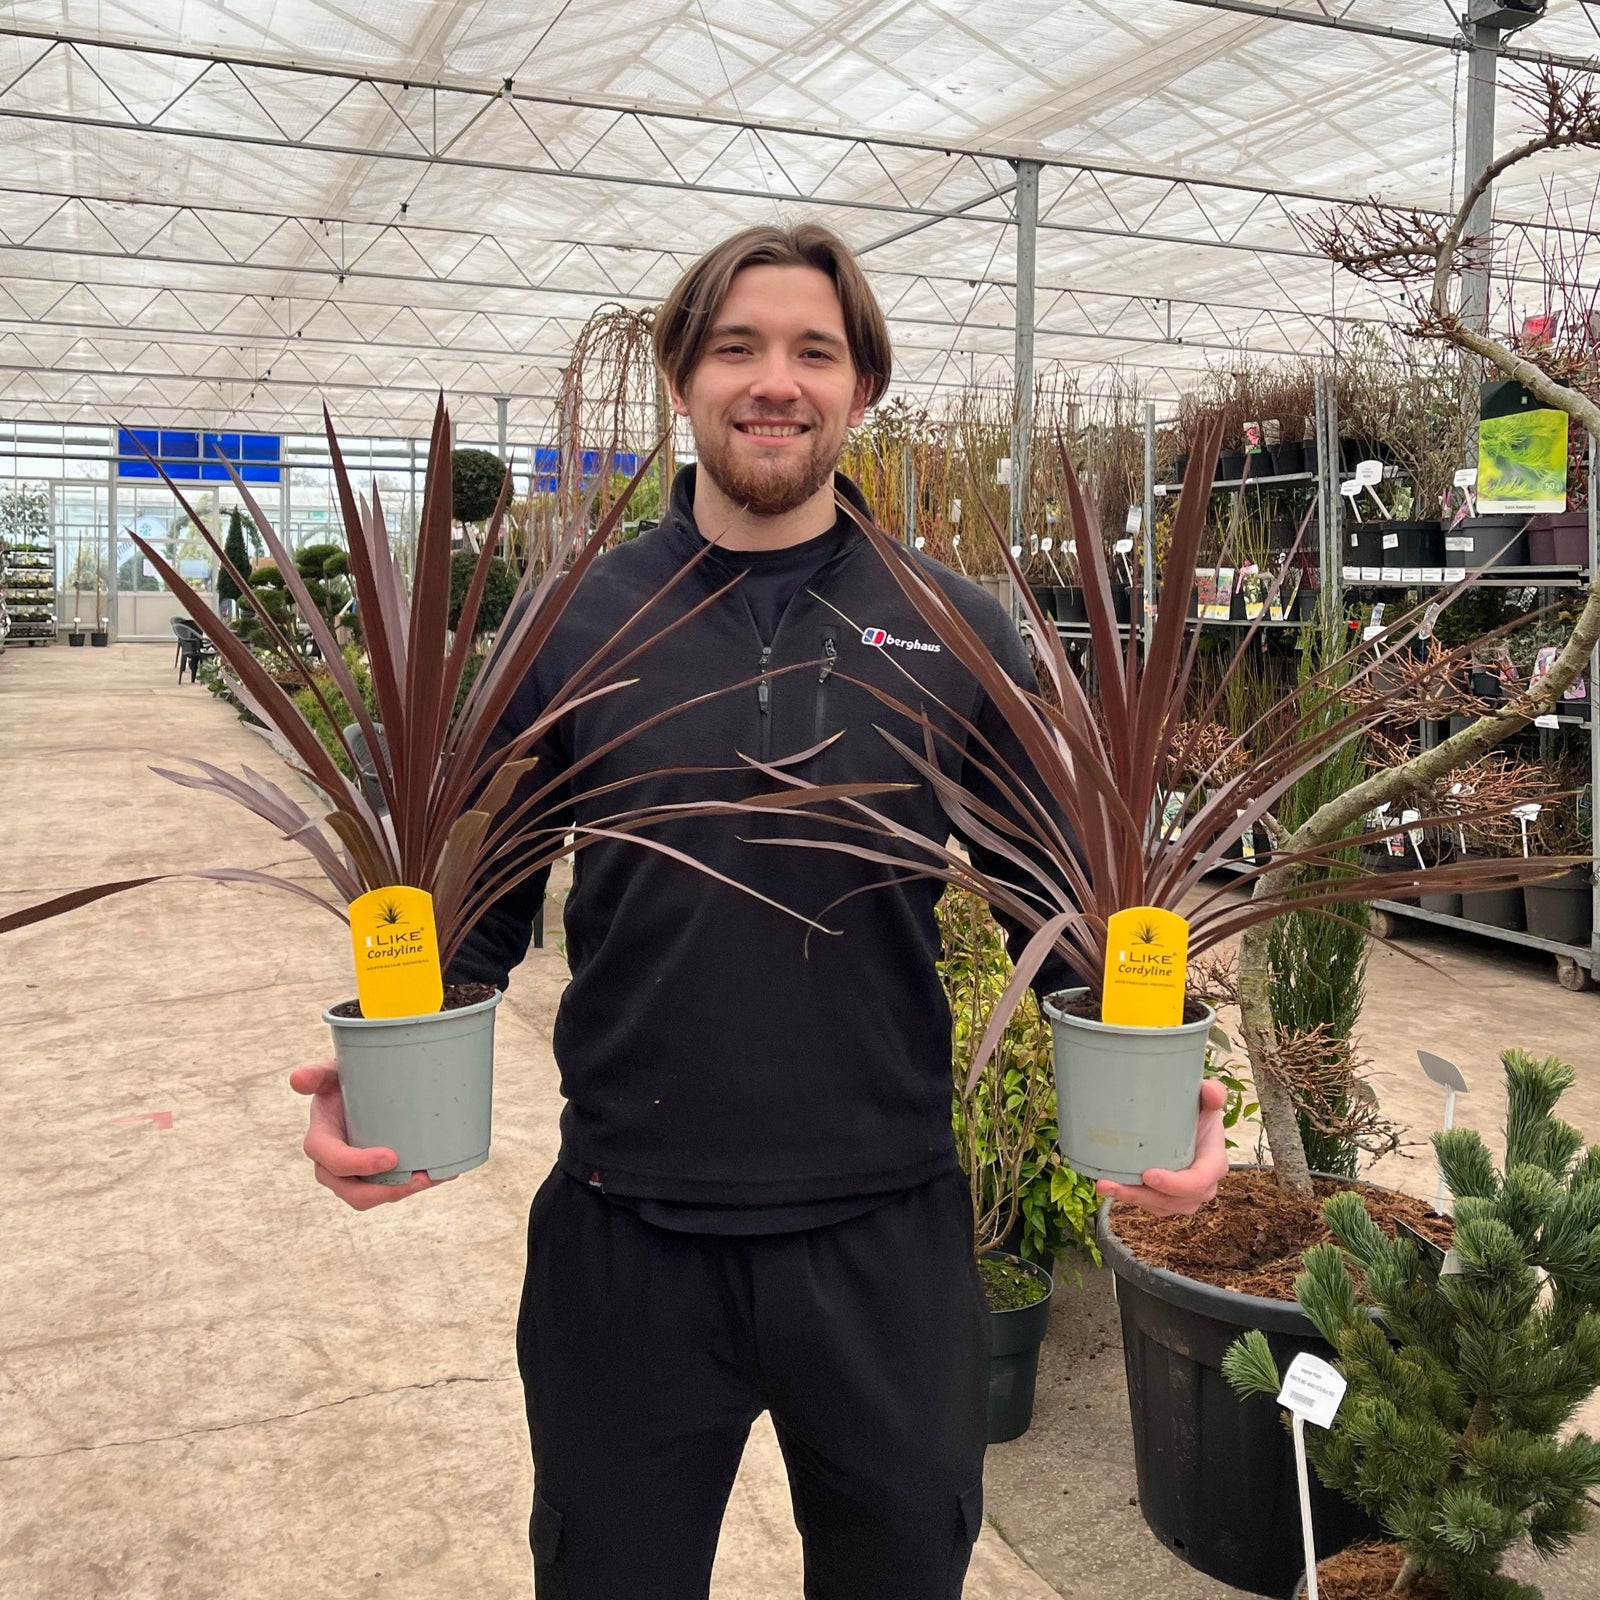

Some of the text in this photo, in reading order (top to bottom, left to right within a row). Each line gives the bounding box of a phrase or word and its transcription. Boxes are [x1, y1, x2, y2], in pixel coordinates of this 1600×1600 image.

[886, 634, 941, 653] berghaus
[376, 931, 422, 946] LIKE
[367, 944, 424, 959] Cordyline
[1129, 951, 1173, 965] LIKE
[1118, 964, 1173, 977] Cordyline
